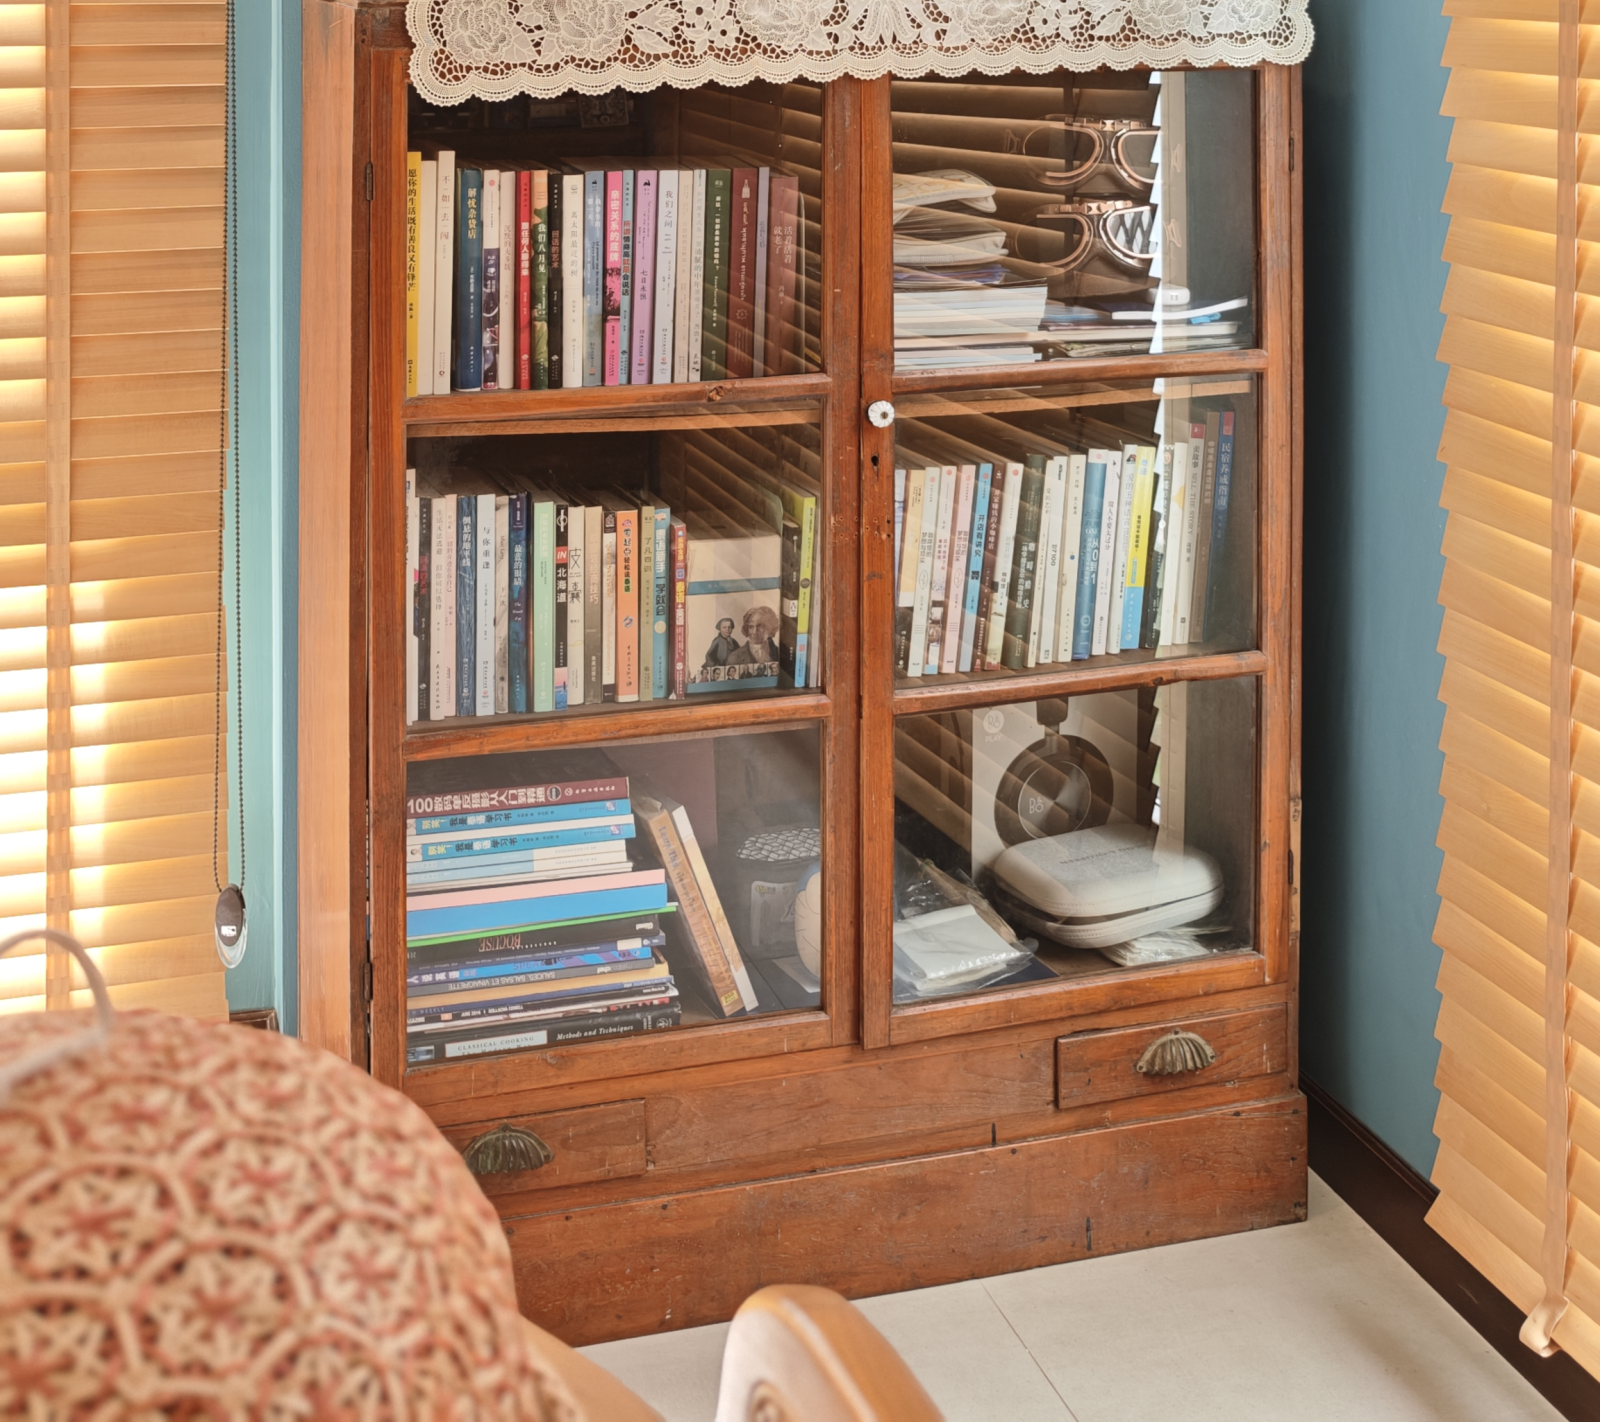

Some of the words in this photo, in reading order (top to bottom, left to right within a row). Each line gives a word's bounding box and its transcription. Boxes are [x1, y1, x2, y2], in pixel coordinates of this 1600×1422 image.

[467, 187, 478, 240] 解忧杂货店
[610, 190, 621, 263] 亲密关系的底牌
[663, 190, 674, 228] 我们之间
[504, 224, 513, 272] 沉默的大多数
[537, 223, 547, 274] 我们八月见
[570, 210, 579, 278] 离太阳最近的树
[622, 220, 631, 296] 所谓情商高就是会说话
[1190, 472, 1198, 490] SELL
[1217, 441, 1231, 507] 民宿养成指南
[988, 488, 1001, 550] 开家赚钱的小咖啡店
[1189, 492, 1197, 509] THE
[974, 514, 985, 558] 开店有讲究
[1187, 509, 1196, 536] STORY
[482, 526, 491, 571] 与你重逢
[513, 544, 523, 587] 最蓝的眼睛
[557, 551, 567, 560] IN
[643, 537, 653, 573] 了凡四训
[1089, 537, 1100, 585] 从0到1
[557, 567, 567, 604] 北海道
[478, 933, 522, 953] BOCUSE
[448, 978, 490, 991] VINAIGRETTE
[491, 977, 500, 986] ET
[501, 974, 526, 985] SALSAS
[457, 1041, 498, 1051] CLASSICAL
[500, 1035, 535, 1046] COOKING
[556, 1031, 582, 1041] Methods
[584, 1028, 597, 1037] and
[599, 1024, 635, 1036] Techniques
